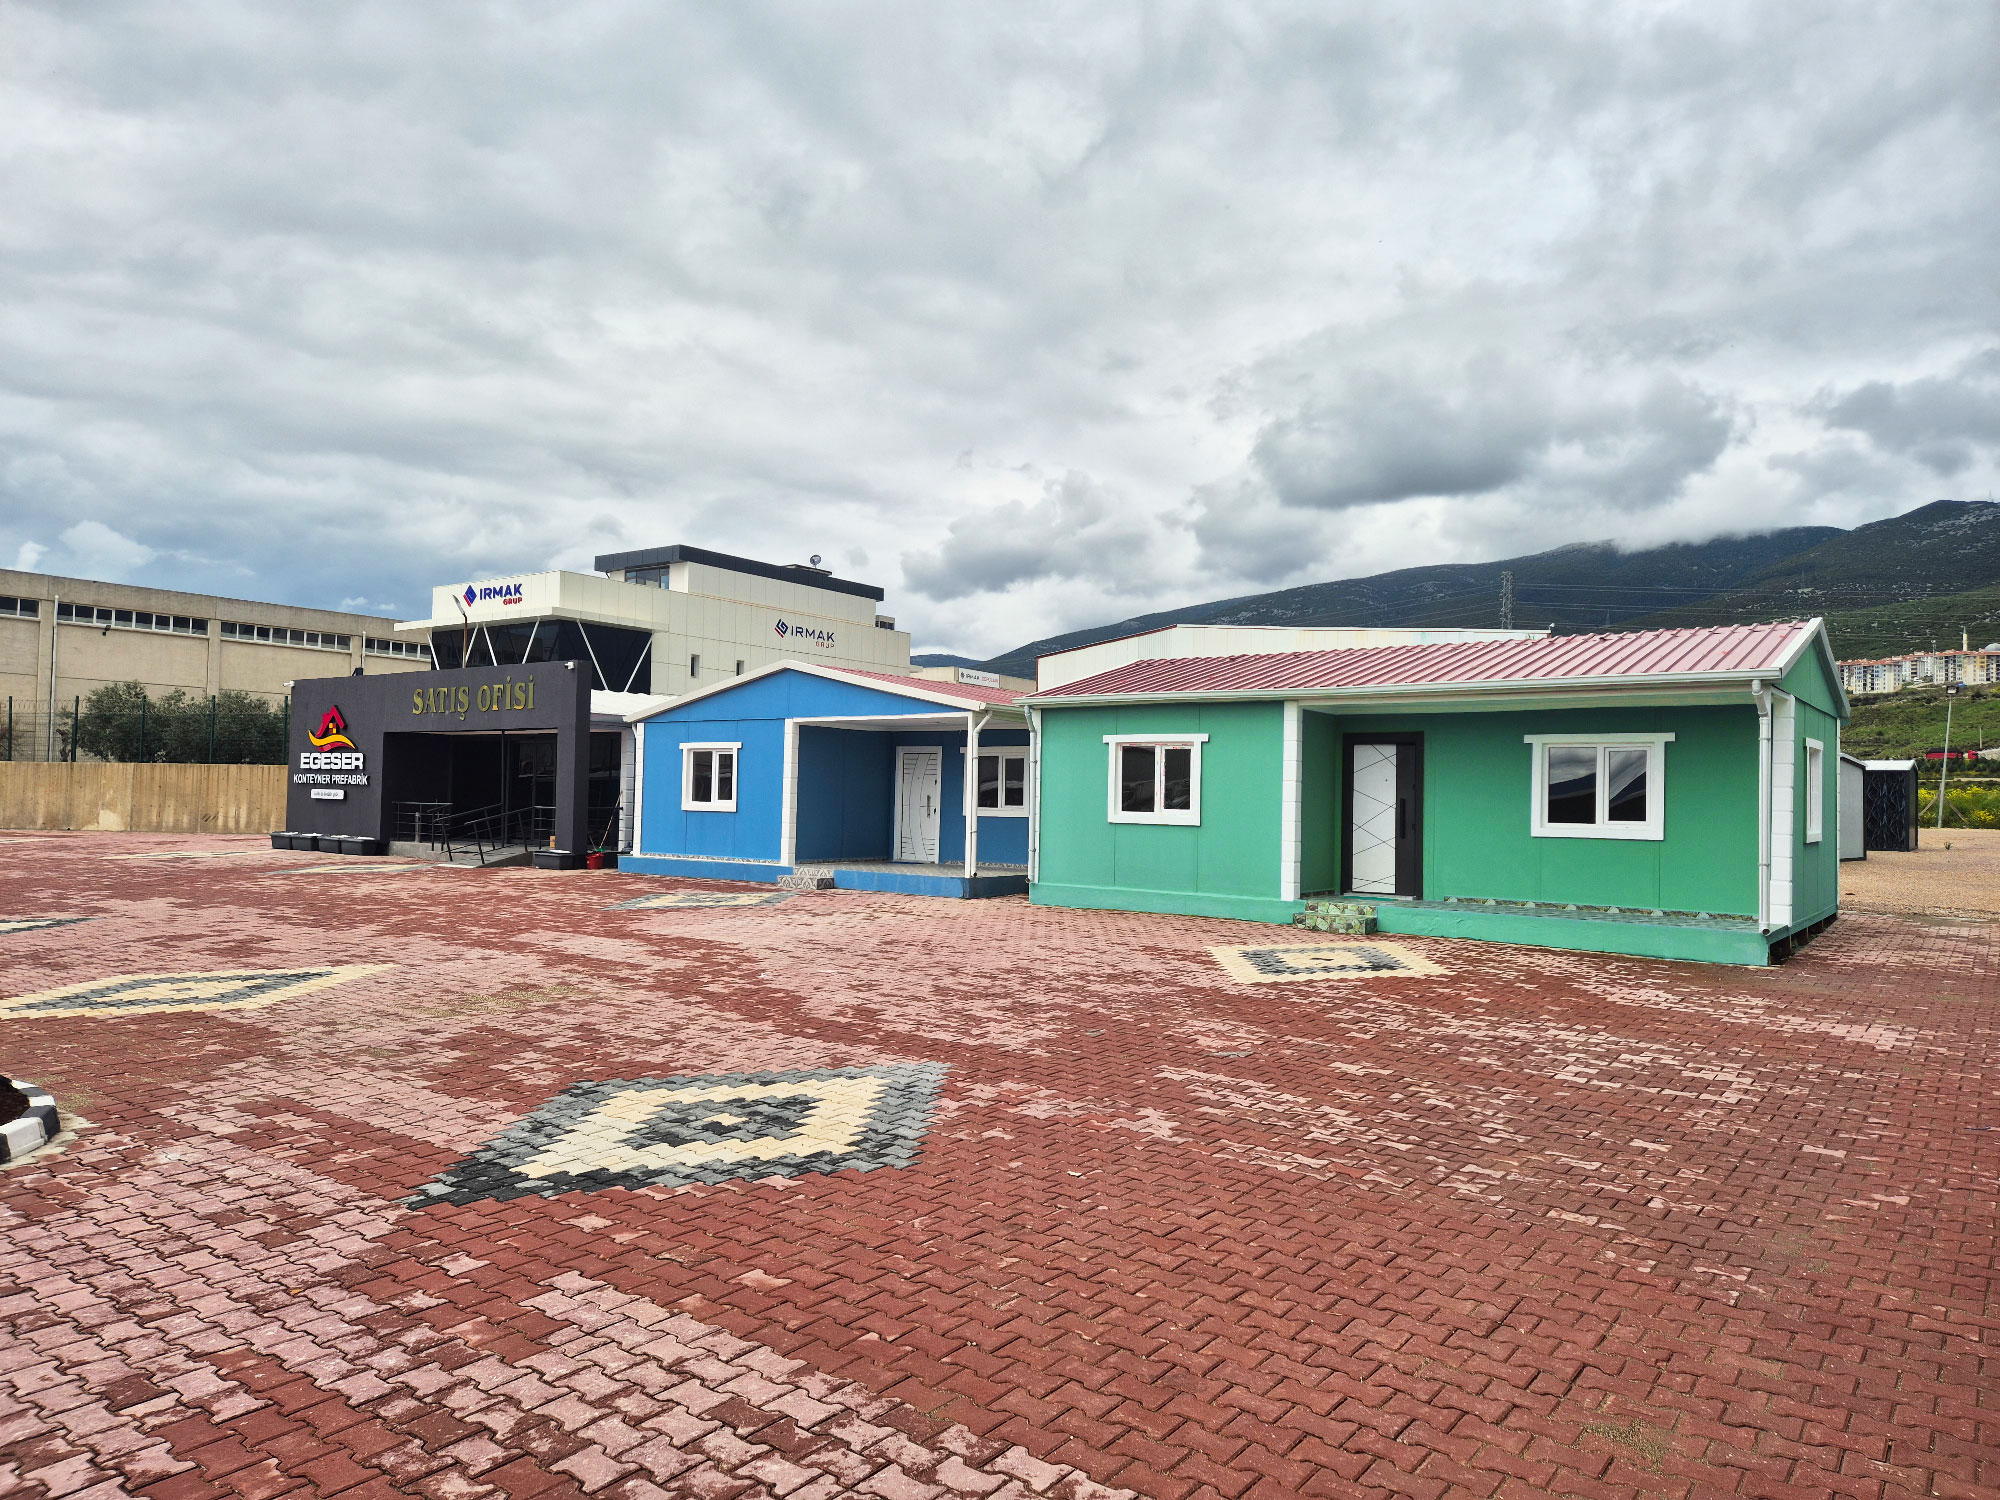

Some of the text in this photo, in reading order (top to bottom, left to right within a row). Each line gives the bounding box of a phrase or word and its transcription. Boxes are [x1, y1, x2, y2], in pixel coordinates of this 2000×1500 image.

[479, 583, 523, 601] IRMAK
[502, 597, 523, 606] GRUP
[791, 625, 835, 643] IRMAK
[412, 674, 535, 721] SATIŞ OFİSİ
[300, 752, 364, 770] EGESER
[293, 772, 368, 786] KONTEYNER PREFABRİK
